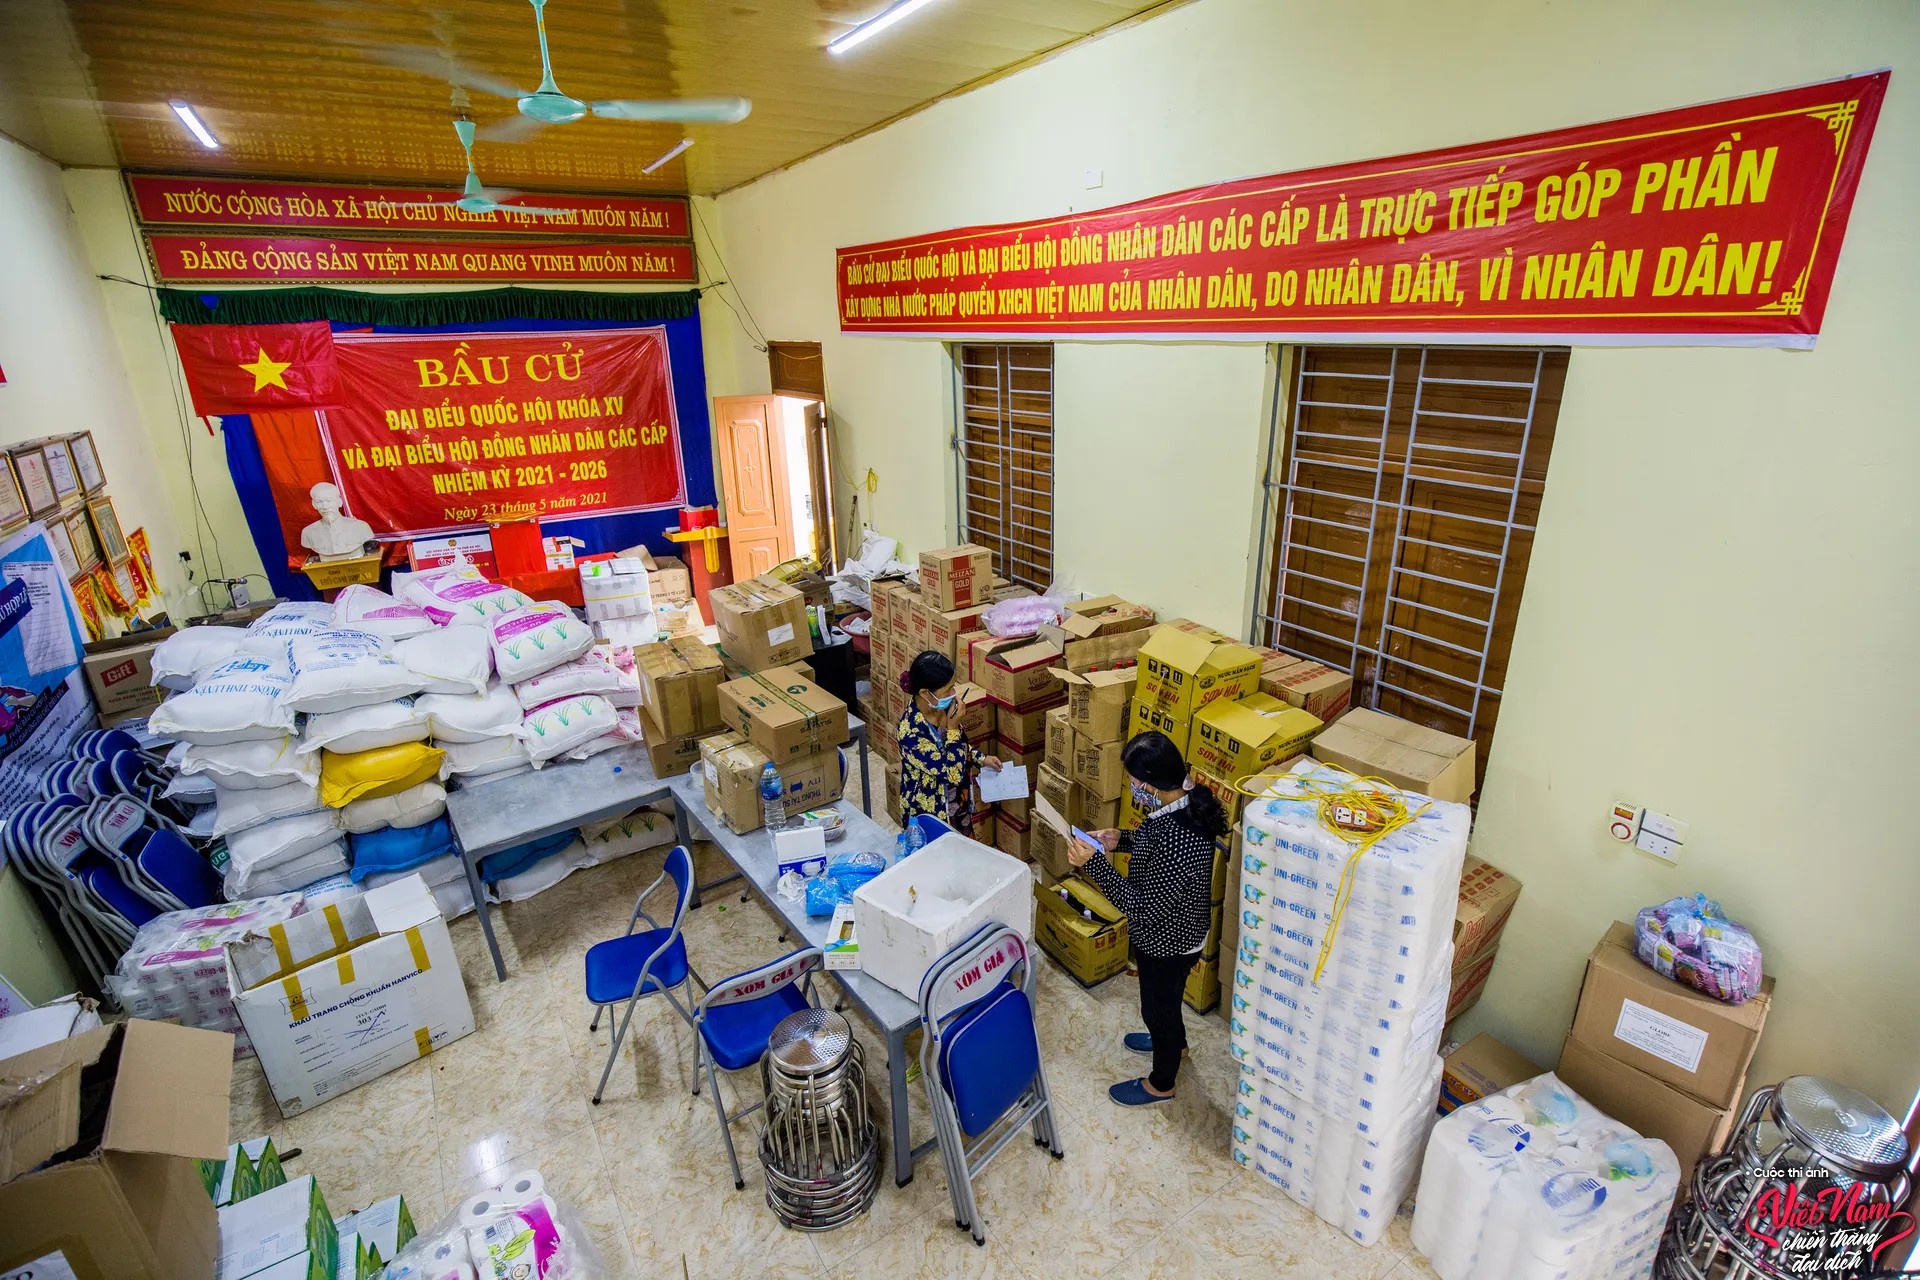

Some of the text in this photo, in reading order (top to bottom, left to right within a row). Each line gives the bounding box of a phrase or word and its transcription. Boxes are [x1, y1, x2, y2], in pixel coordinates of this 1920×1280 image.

[164, 188, 222, 215] NƯỚC
[226, 190, 283, 220] CỘNG
[287, 192, 330, 218] HÒA
[333, 196, 362, 219] XÃ
[364, 196, 399, 224] HỘI
[403, 195, 438, 222] CHỦ
[543, 208, 578, 225] NAM
[581, 205, 626, 226] MUÔN
[847, 132, 1780, 288] BẦU CỬ ĐẠI BIỂU QUỐC HỘI VÀ ĐẠI BIỂU HỘI ĐỒNG NHÂN DÂN CÁC CẤP LÀ TRỰC TIẾP GÓP PHẦN
[180, 241, 247, 270] ĐẢNG
[252, 245, 312, 275] CỘNG
[317, 244, 359, 271] SẢN
[362, 248, 409, 275] VIỆT
[414, 254, 459, 271] NAM
[463, 254, 527, 273] QUANG
[530, 255, 576, 272] VINH
[578, 251, 627, 272] MUÔN
[845, 232, 1783, 322] XÂY DỰNG NHÀ NƯỚC PHÁP QUYỀN XHCN VIỆT NAM CỦA NHÂN DÂN, DO NHÂN DÂN, VÌ NHÂN DÂN!
[414, 341, 585, 388] BẦU CỬ
[386, 394, 623, 436] ĐẠI BIỂU QUỐC HỘI KHÓA XV
[342, 419, 667, 472] VÀ ĐẠI BIỂU HỘI ĐỒNG NHÂN DÂN CÁC CẤP
[432, 468, 488, 499] NHIỆM
[491, 463, 511, 488] KỲ
[515, 465, 553, 488] 2021
[571, 459, 608, 482] 2026
[444, 491, 607, 522] Ngày 23 tháng 5 năm 2021
[948, 568, 975, 580] MEIZAN
[954, 579, 971, 589] GOLD
[106, 664, 132, 683] Gift
[1223, 679, 1242, 698] HẢI
[1197, 746, 1237, 774] SƠN HẢI
[807, 777, 821, 787] ITV
[1275, 838, 1319, 861] UNI-GREEN
[1273, 867, 1318, 890] UNI-GREEN
[1272, 896, 1317, 920] UNI-GREEN
[1270, 923, 1314, 948] UNI-GREEN
[289, 968, 423, 1030] KHẨU TRANG CHỐNG KHUẨN HANVICO
[1259, 984, 1298, 1011] UNI-GREEN
[1256, 1008, 1294, 1036] UNI-GREEN
[1259, 1094, 1296, 1122] UNI-GREEN
[1258, 1118, 1294, 1145] UNI-GREEN
